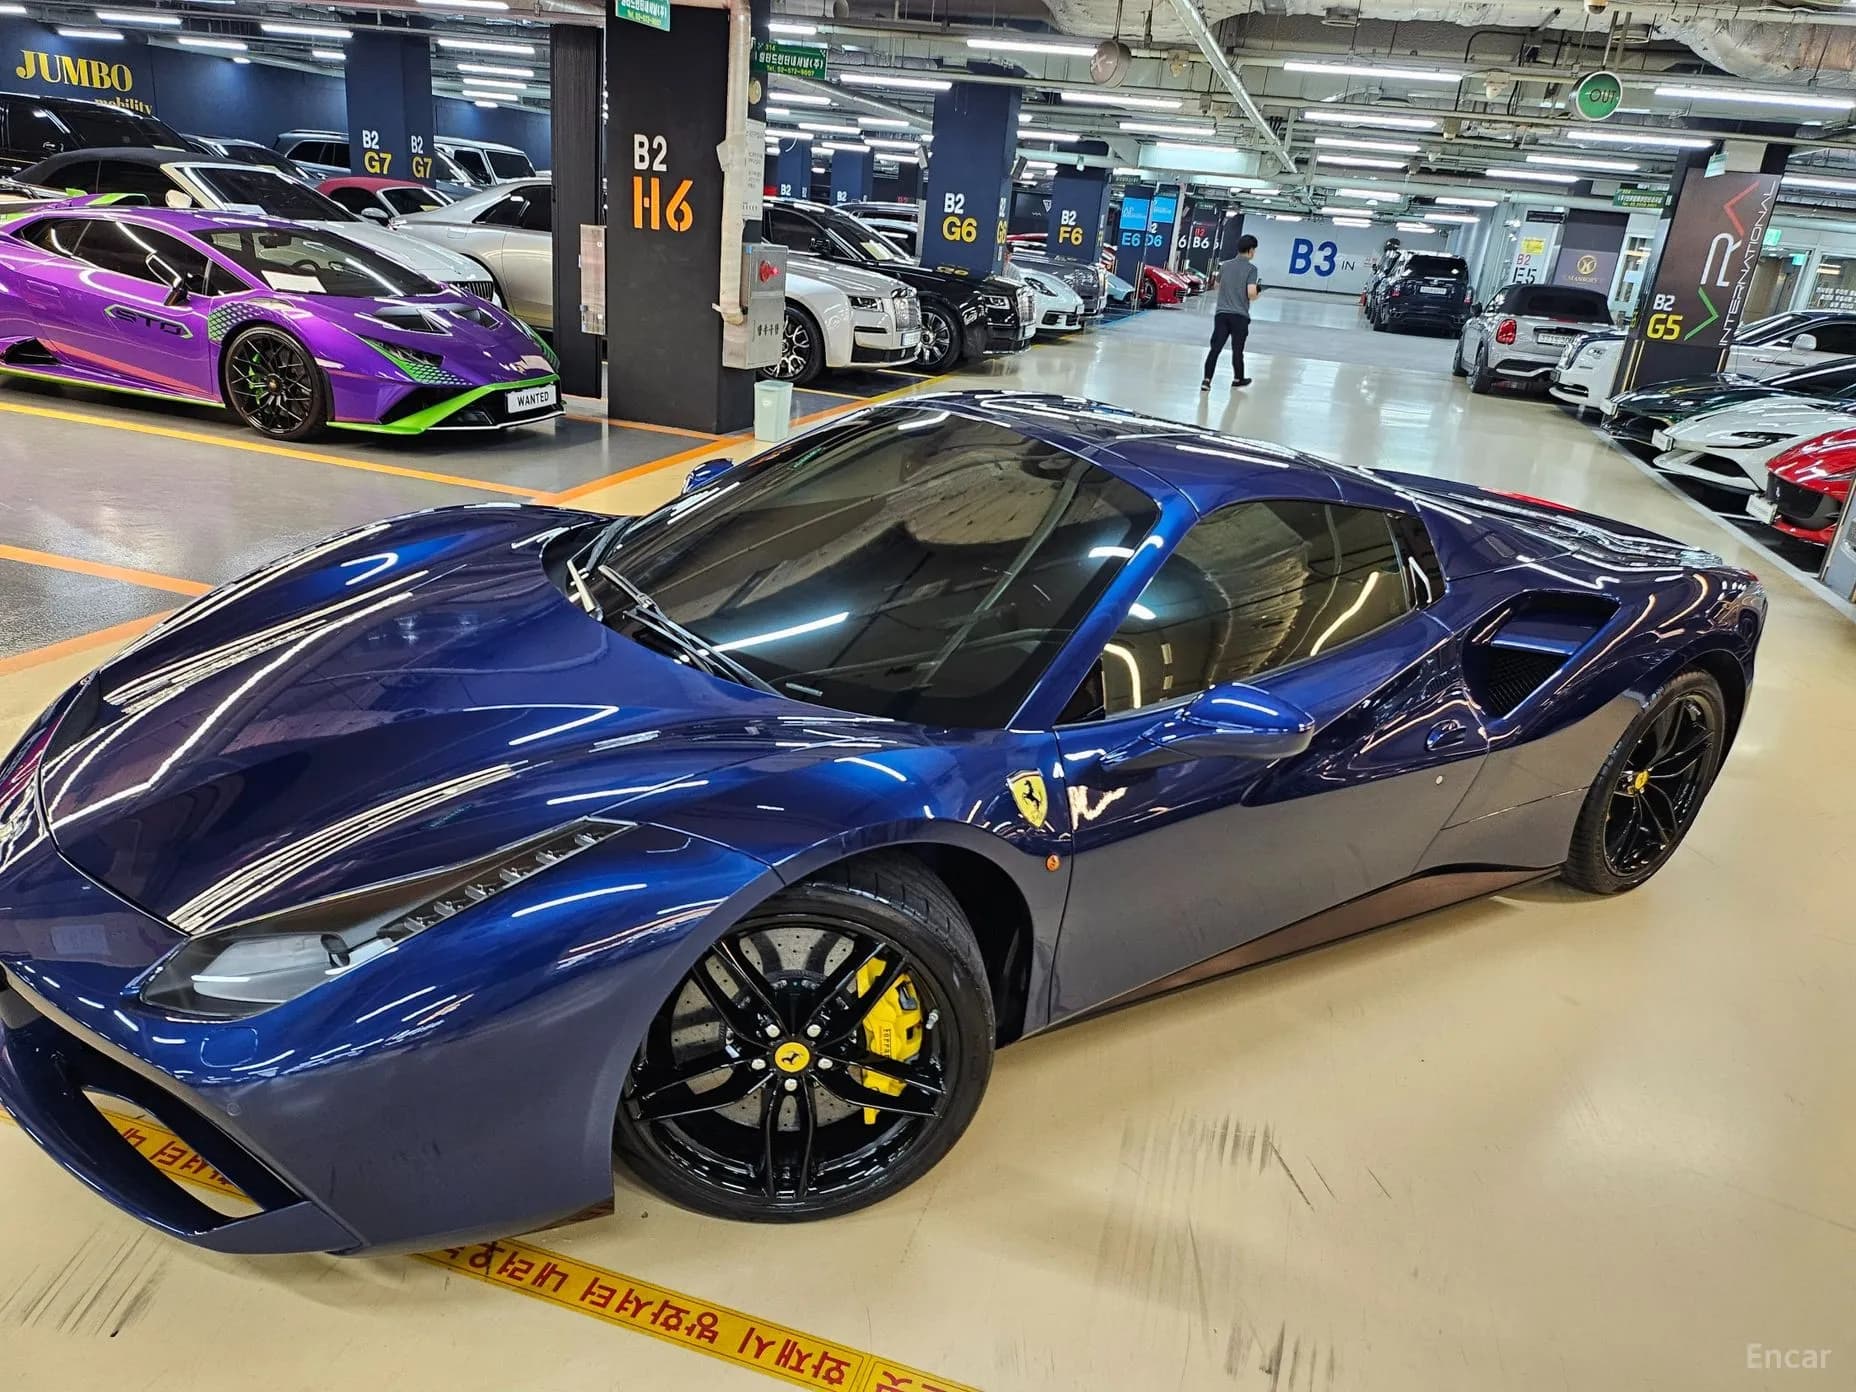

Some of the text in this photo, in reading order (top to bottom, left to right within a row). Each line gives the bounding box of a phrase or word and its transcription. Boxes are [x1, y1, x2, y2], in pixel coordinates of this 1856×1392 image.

[15, 49, 134, 92] JUMBO
[1589, 88, 1617, 104] OUT
[362, 129, 380, 150] B2
[410, 135, 424, 154] B2
[364, 150, 392, 175] G7
[633, 133, 668, 172] B2
[412, 156, 433, 179] G7
[780, 183, 792, 196] B2
[836, 190, 848, 202] B2
[632, 175, 694, 233] H6
[943, 192, 965, 214] B2
[1061, 209, 1077, 226] B2
[942, 215, 978, 243] G6
[1058, 226, 1084, 246] F6
[1121, 232, 1141, 247] E6
[1193, 236, 1210, 249] B6
[1288, 237, 1338, 278] B3
[1341, 260, 1356, 271] IN
[1516, 253, 1531, 266] B2
[1718, 180, 1777, 347] INTERNATIONAL
[1511, 266, 1537, 285] E5
[1652, 293, 1676, 312] B2
[111, 307, 182, 336] STO
[1646, 312, 1683, 341] G5
[517, 391, 550, 407] WANTED
[579, 1276, 719, 1344] 방화셔터
[737, 1327, 850, 1385] 화재시
